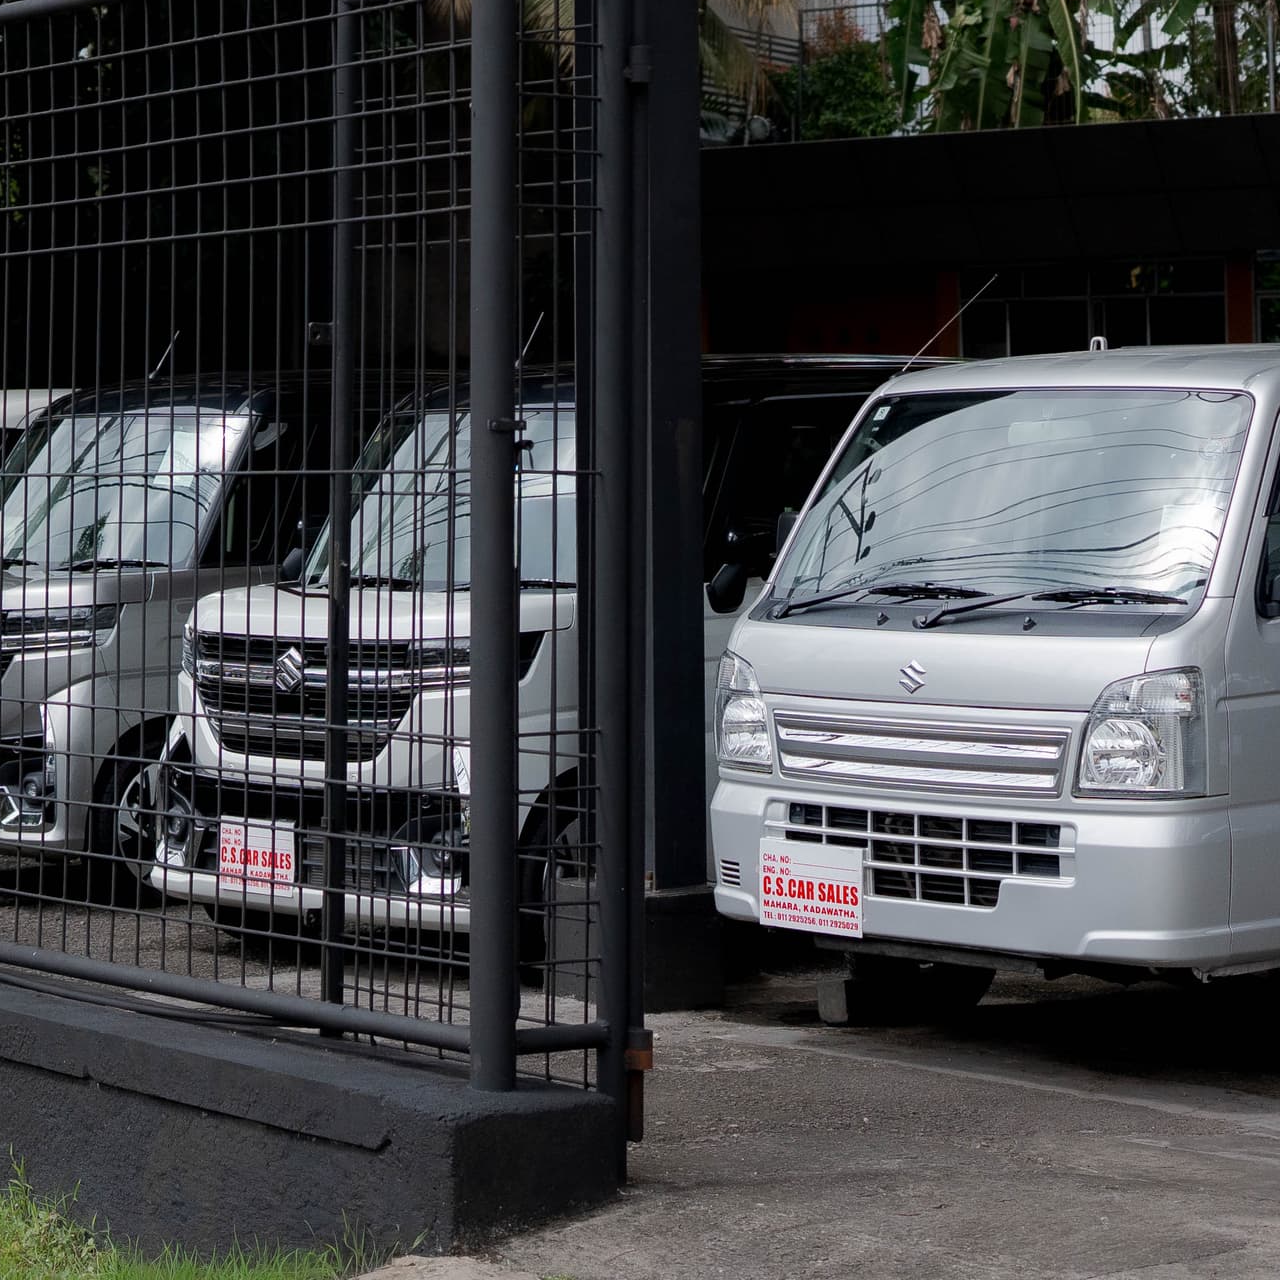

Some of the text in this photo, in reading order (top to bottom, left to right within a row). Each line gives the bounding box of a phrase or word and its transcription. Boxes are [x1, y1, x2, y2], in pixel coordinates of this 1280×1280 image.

[818, 882, 859, 907] SALES
[763, 899, 859, 919] MAHARA, KADAWATHA.
